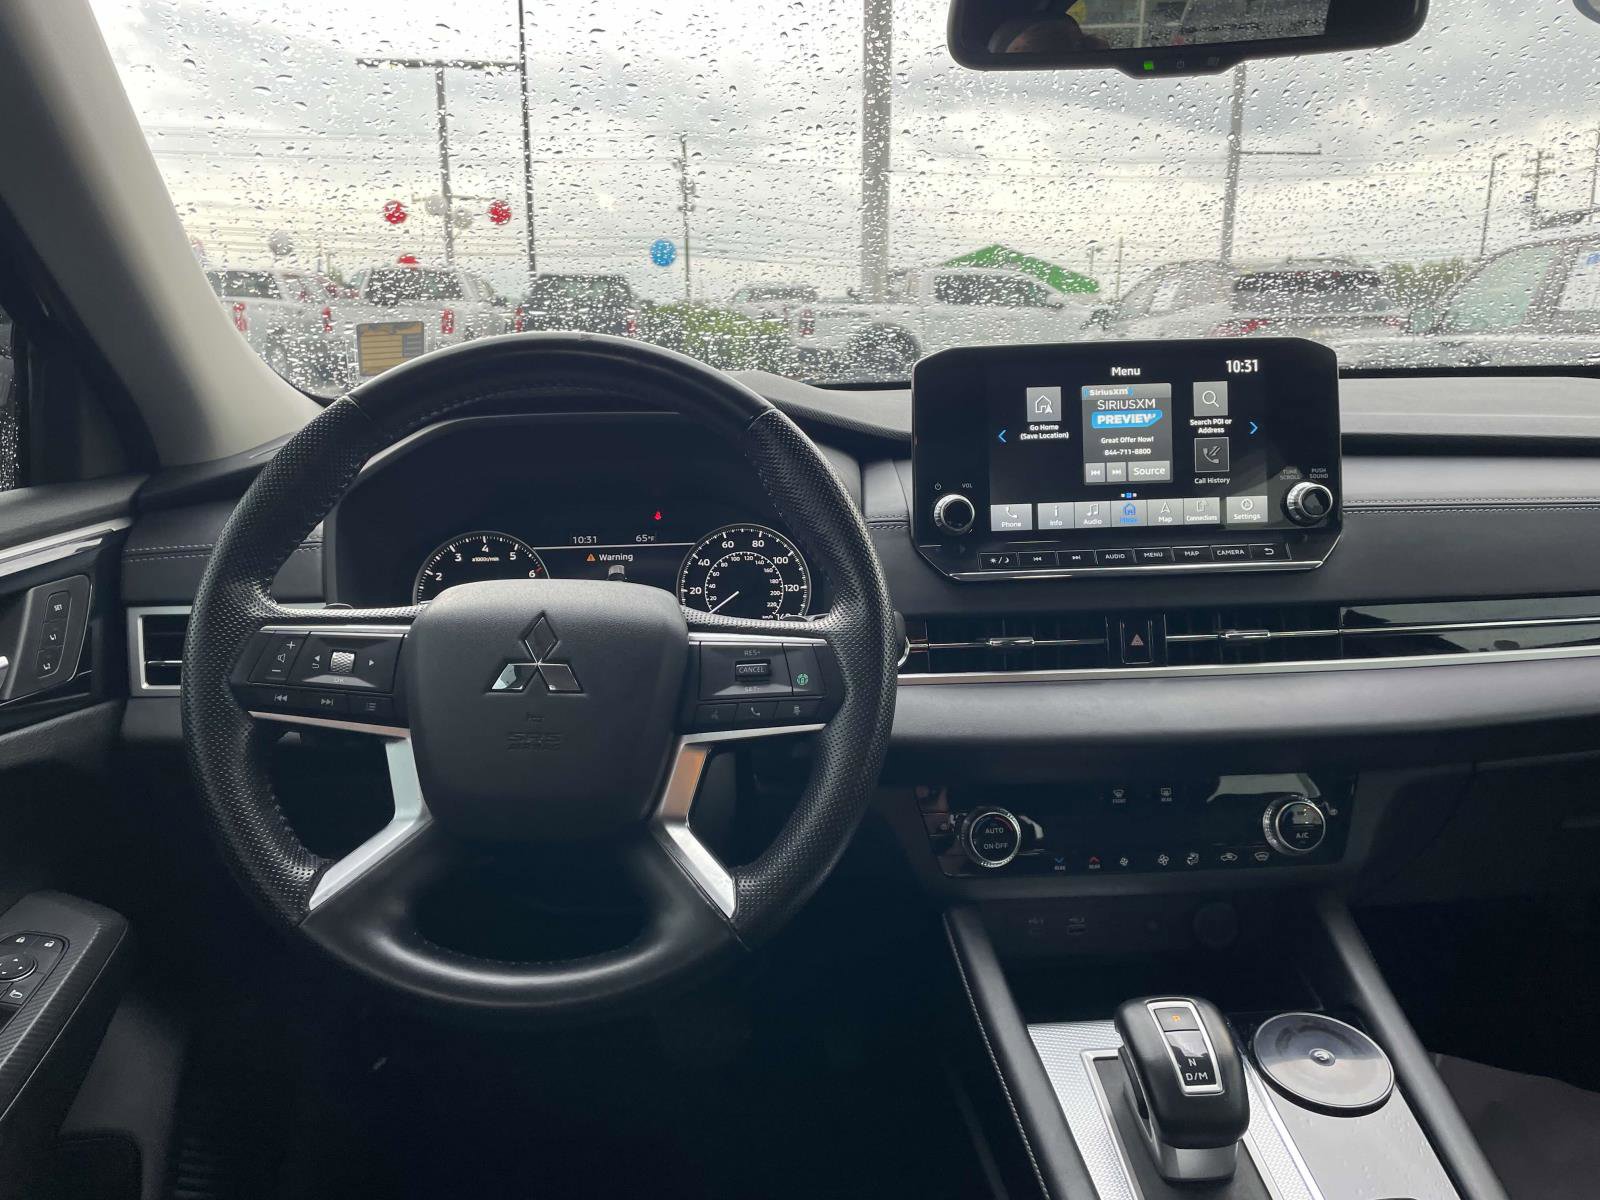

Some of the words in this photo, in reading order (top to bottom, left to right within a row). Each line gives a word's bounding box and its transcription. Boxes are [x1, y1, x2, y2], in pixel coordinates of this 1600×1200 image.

[1110, 366, 1141, 376] Menu
[1225, 359, 1258, 374] 10:31
[1097, 398, 1156, 410] SIRIUSXM
[1097, 413, 1156, 425] PREVIEW
[1133, 467, 1166, 476] Source
[572, 535, 598, 544] 10:31
[454, 554, 462, 562] 3
[509, 552, 516, 560] 5
[1188, 1059, 1197, 1067] N
[1185, 1072, 1208, 1081] D/M
